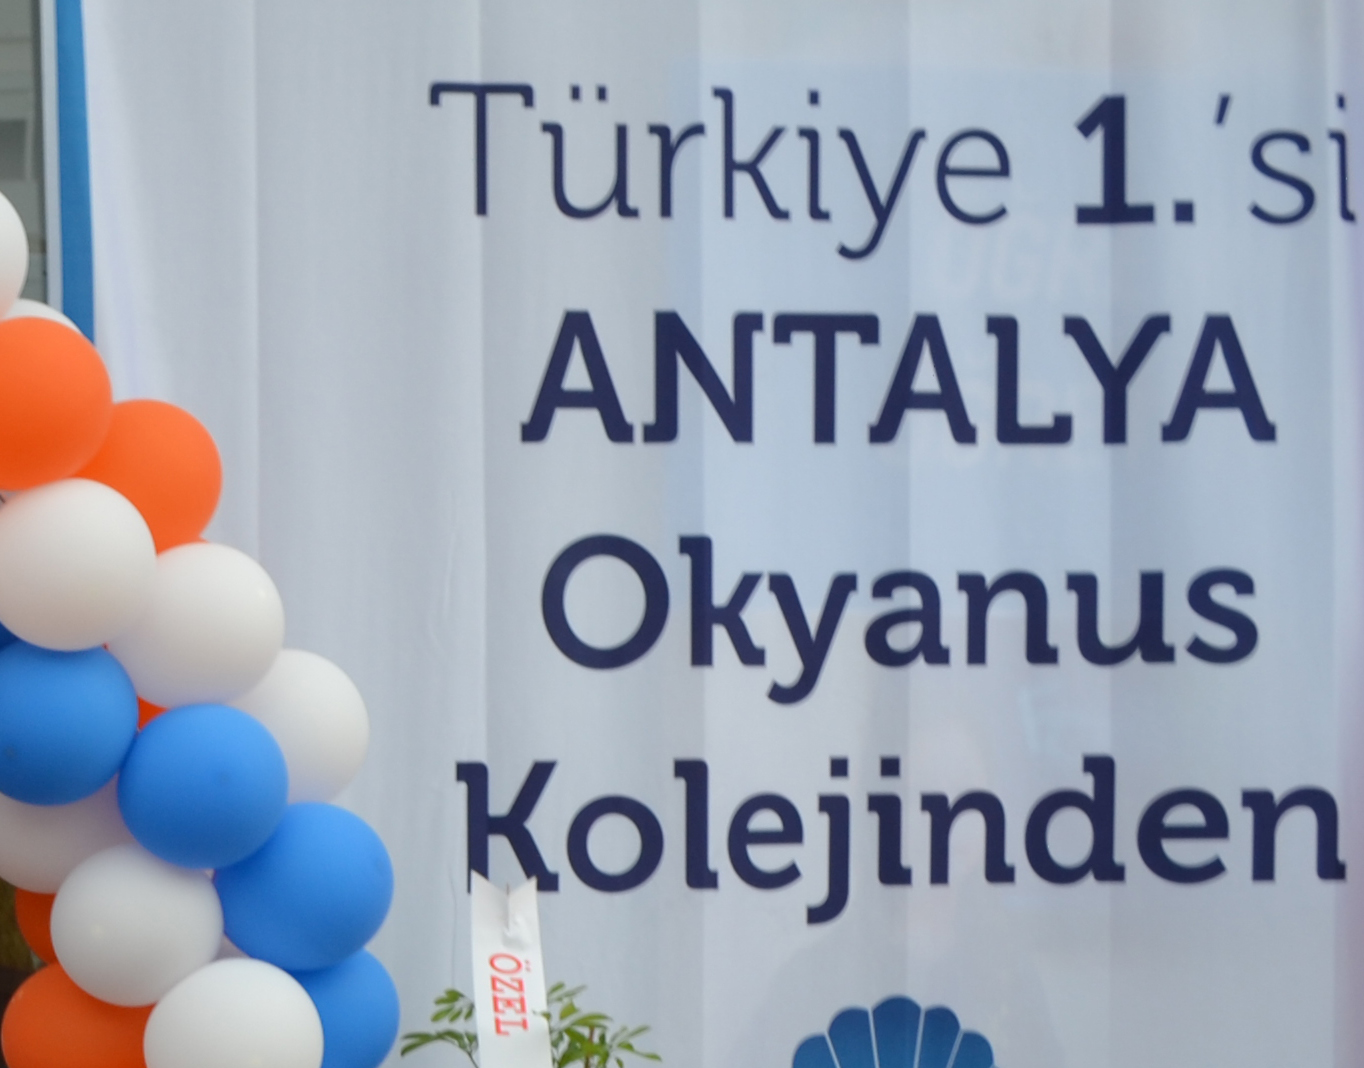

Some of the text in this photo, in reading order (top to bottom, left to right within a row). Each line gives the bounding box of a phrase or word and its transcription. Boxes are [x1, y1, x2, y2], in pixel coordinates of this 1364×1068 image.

[429, 82, 1011, 260] Türkiye
[520, 310, 1277, 446] ANTALYA
[541, 534, 1259, 705] Okyanus
[456, 754, 1347, 925] Kolejinden
[488, 952, 532, 1036] ÖZEL
